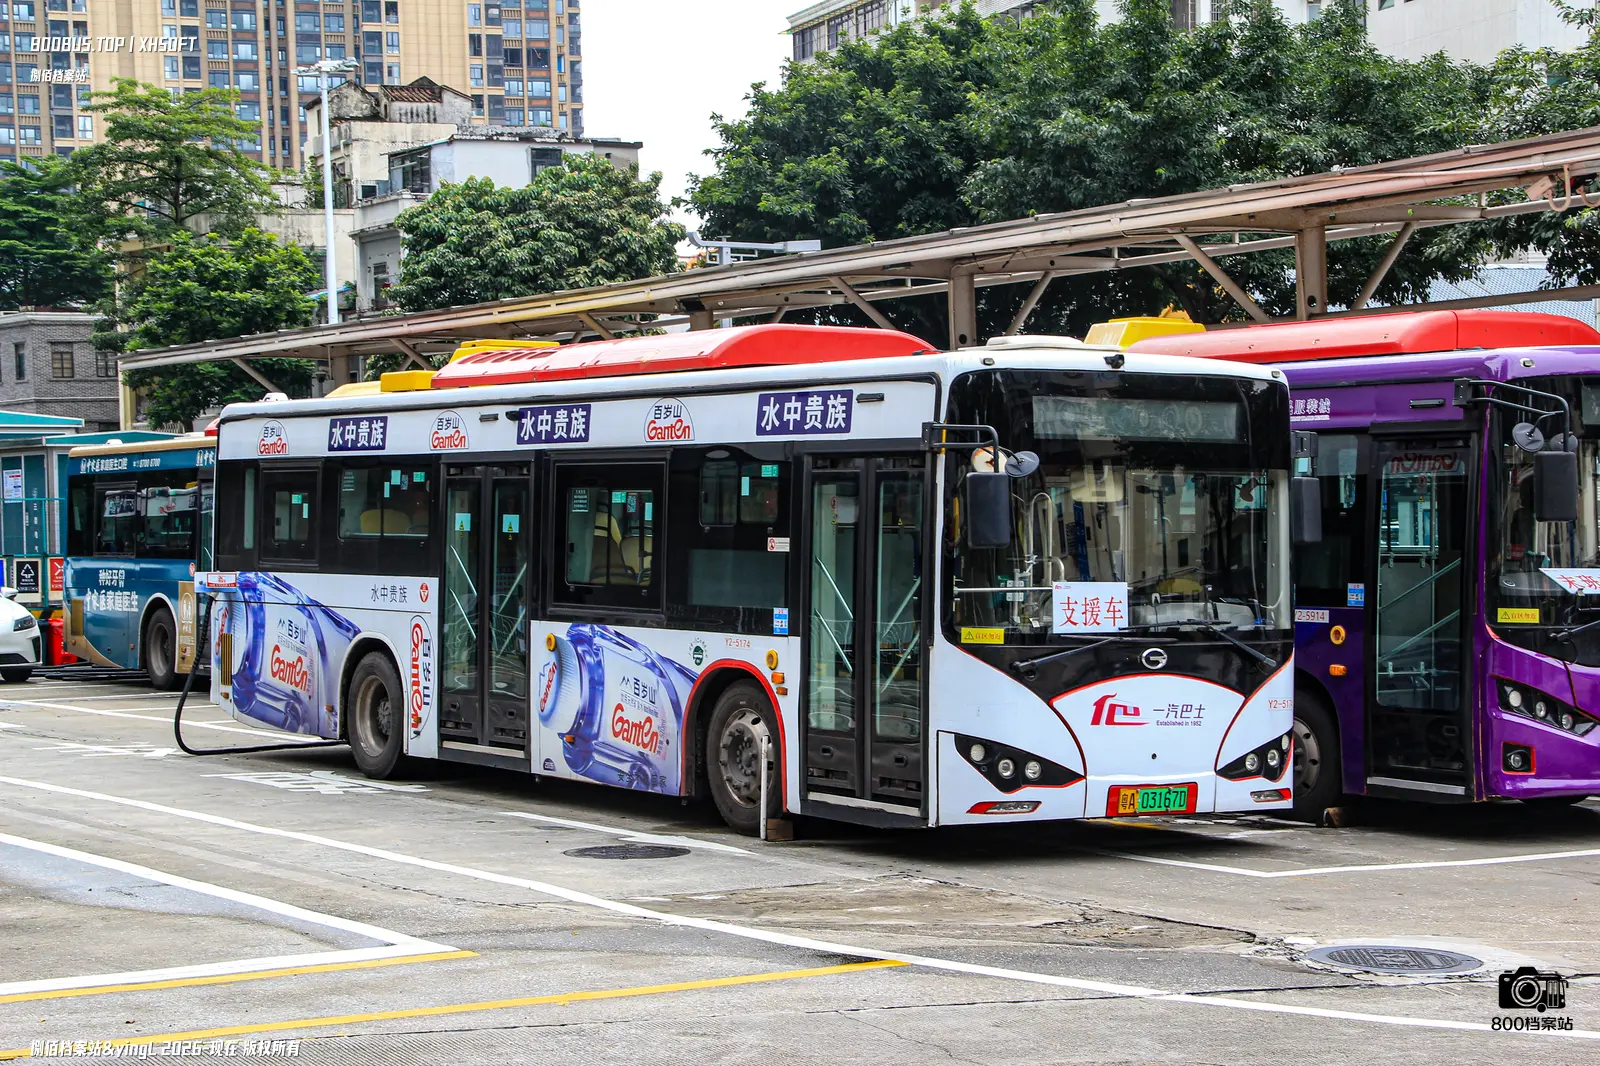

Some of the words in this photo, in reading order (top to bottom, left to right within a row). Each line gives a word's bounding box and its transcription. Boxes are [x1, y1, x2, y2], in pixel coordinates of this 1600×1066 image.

[436, 416, 460, 431] 百岁山
[519, 407, 588, 440] 水中贵族
[653, 404, 682, 420] 百岁山
[761, 393, 848, 431] 水中贵族
[263, 426, 282, 438] 百岁山
[330, 419, 385, 448] 水中贵族
[431, 429, 467, 450] Ganten
[646, 418, 692, 441] Ganten
[258, 437, 287, 454] Ganten
[371, 584, 408, 603] 水中贵族
[1556, 574, 1600, 590] 末班
[1059, 596, 1124, 627] 支援车
[287, 619, 307, 645] 百岁山
[725, 637, 751, 648] Y2-5174
[270, 644, 308, 693] Ganten
[411, 623, 424, 729] Ganten
[422, 638, 432, 706] 百岁山
[633, 676, 656, 705] 百岁山
[1152, 703, 1206, 719] 一汽巴士
[611, 703, 659, 754] Ganten
[1120, 792, 1135, 811] 粤A
[1140, 789, 1187, 810] 03167D
